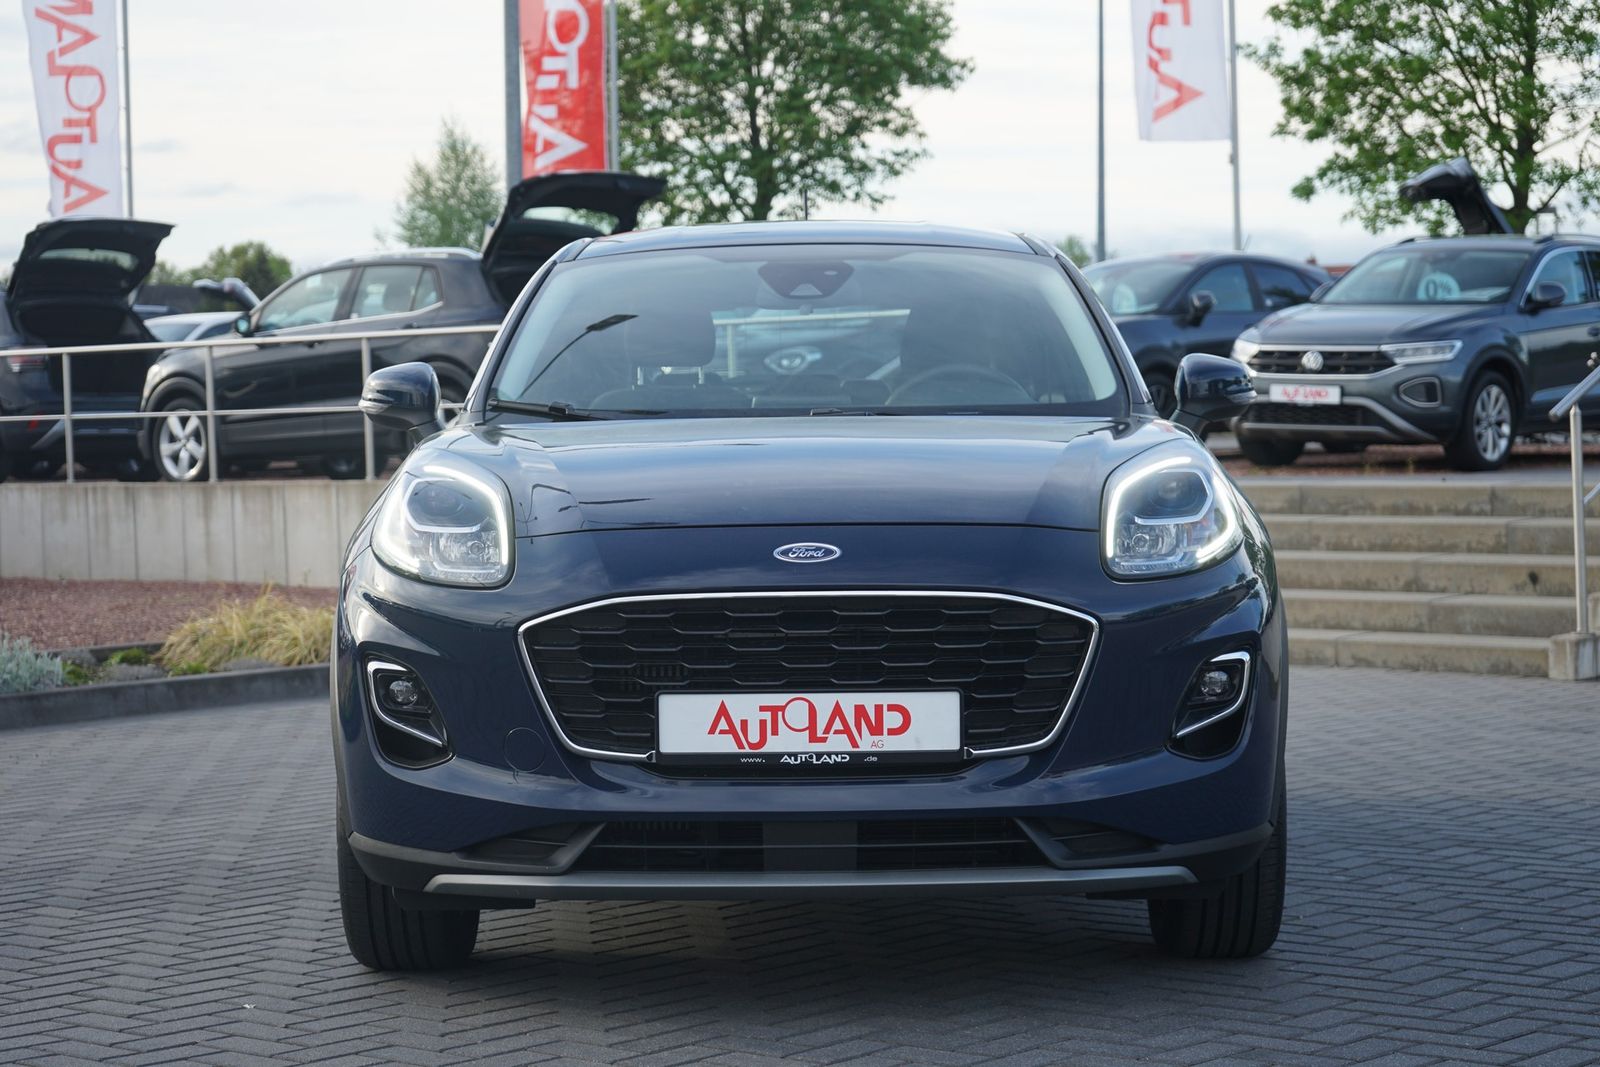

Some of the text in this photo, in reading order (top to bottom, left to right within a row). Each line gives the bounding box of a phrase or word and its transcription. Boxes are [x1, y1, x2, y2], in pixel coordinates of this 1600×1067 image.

[788, 546, 826, 558] Ford
[707, 696, 912, 750] AUTOLAND
[869, 739, 885, 749] AG
[779, 753, 850, 764] AUTOLAND
